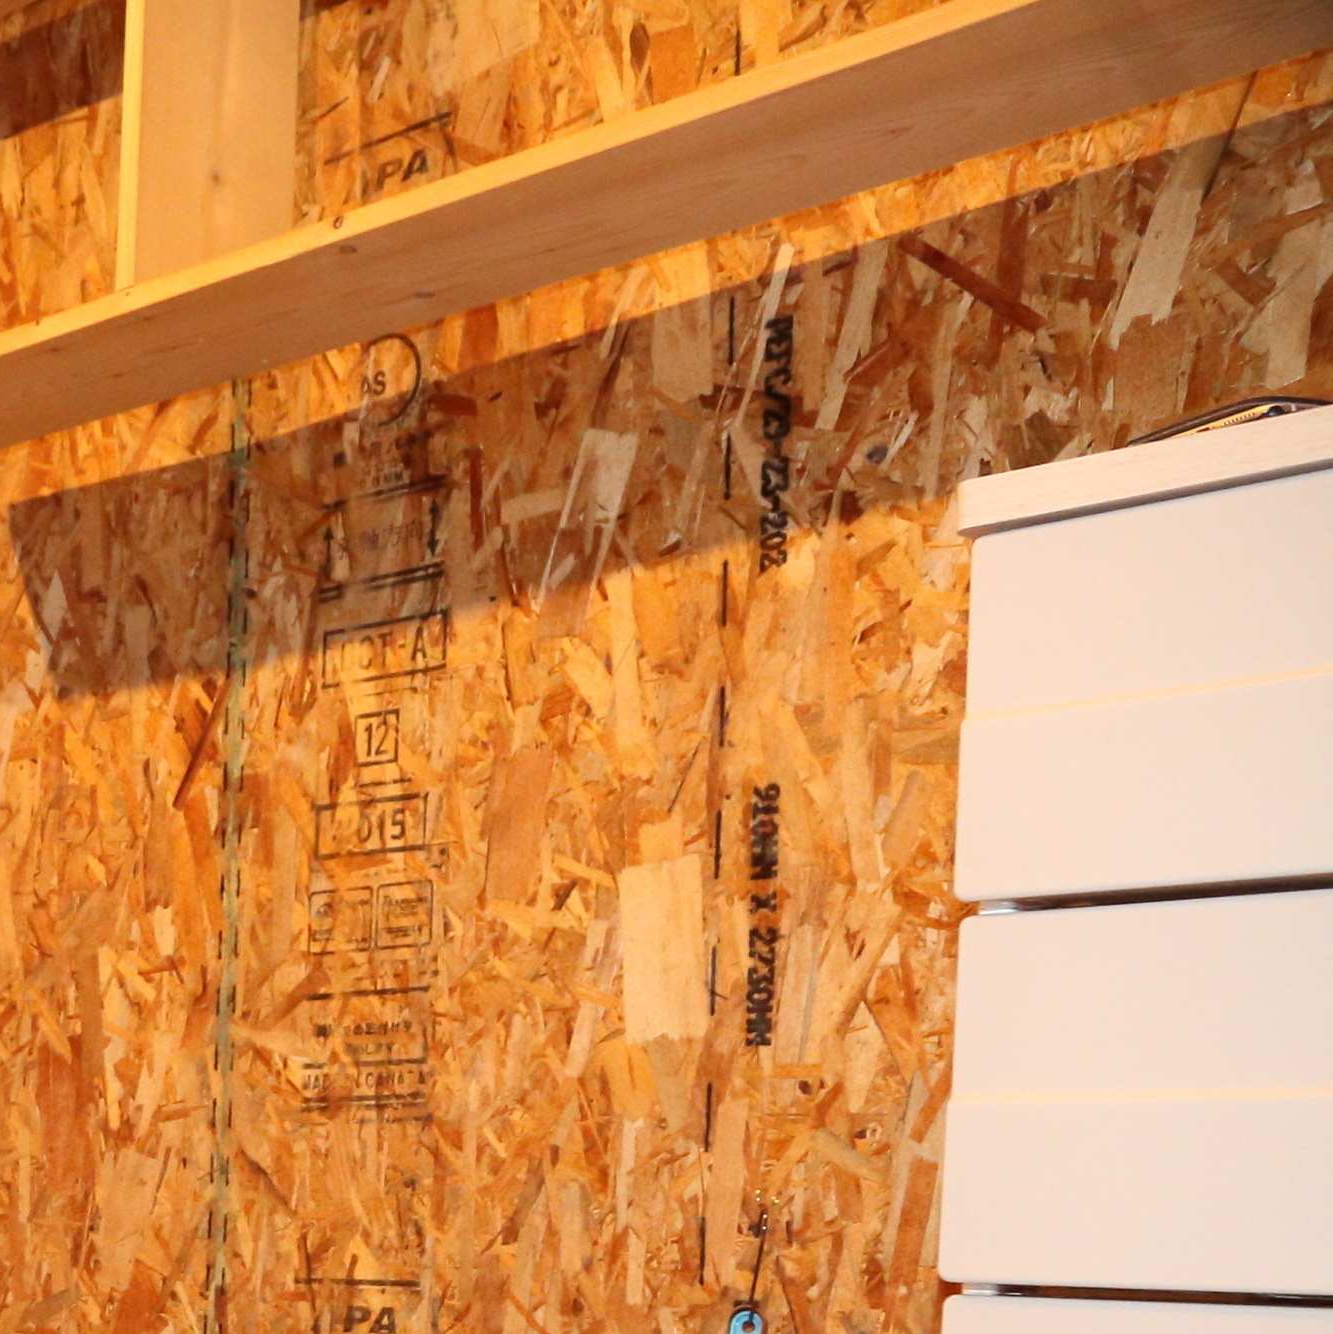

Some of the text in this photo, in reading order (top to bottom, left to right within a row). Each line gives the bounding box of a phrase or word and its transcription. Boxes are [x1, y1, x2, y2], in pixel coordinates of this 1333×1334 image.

[364, 720, 390, 758] 12
[331, 807, 407, 843] 015
[749, 783, 781, 881] 910MM
[745, 926, 779, 1048] 2730MM
[331, 1305, 397, 1334] PA
